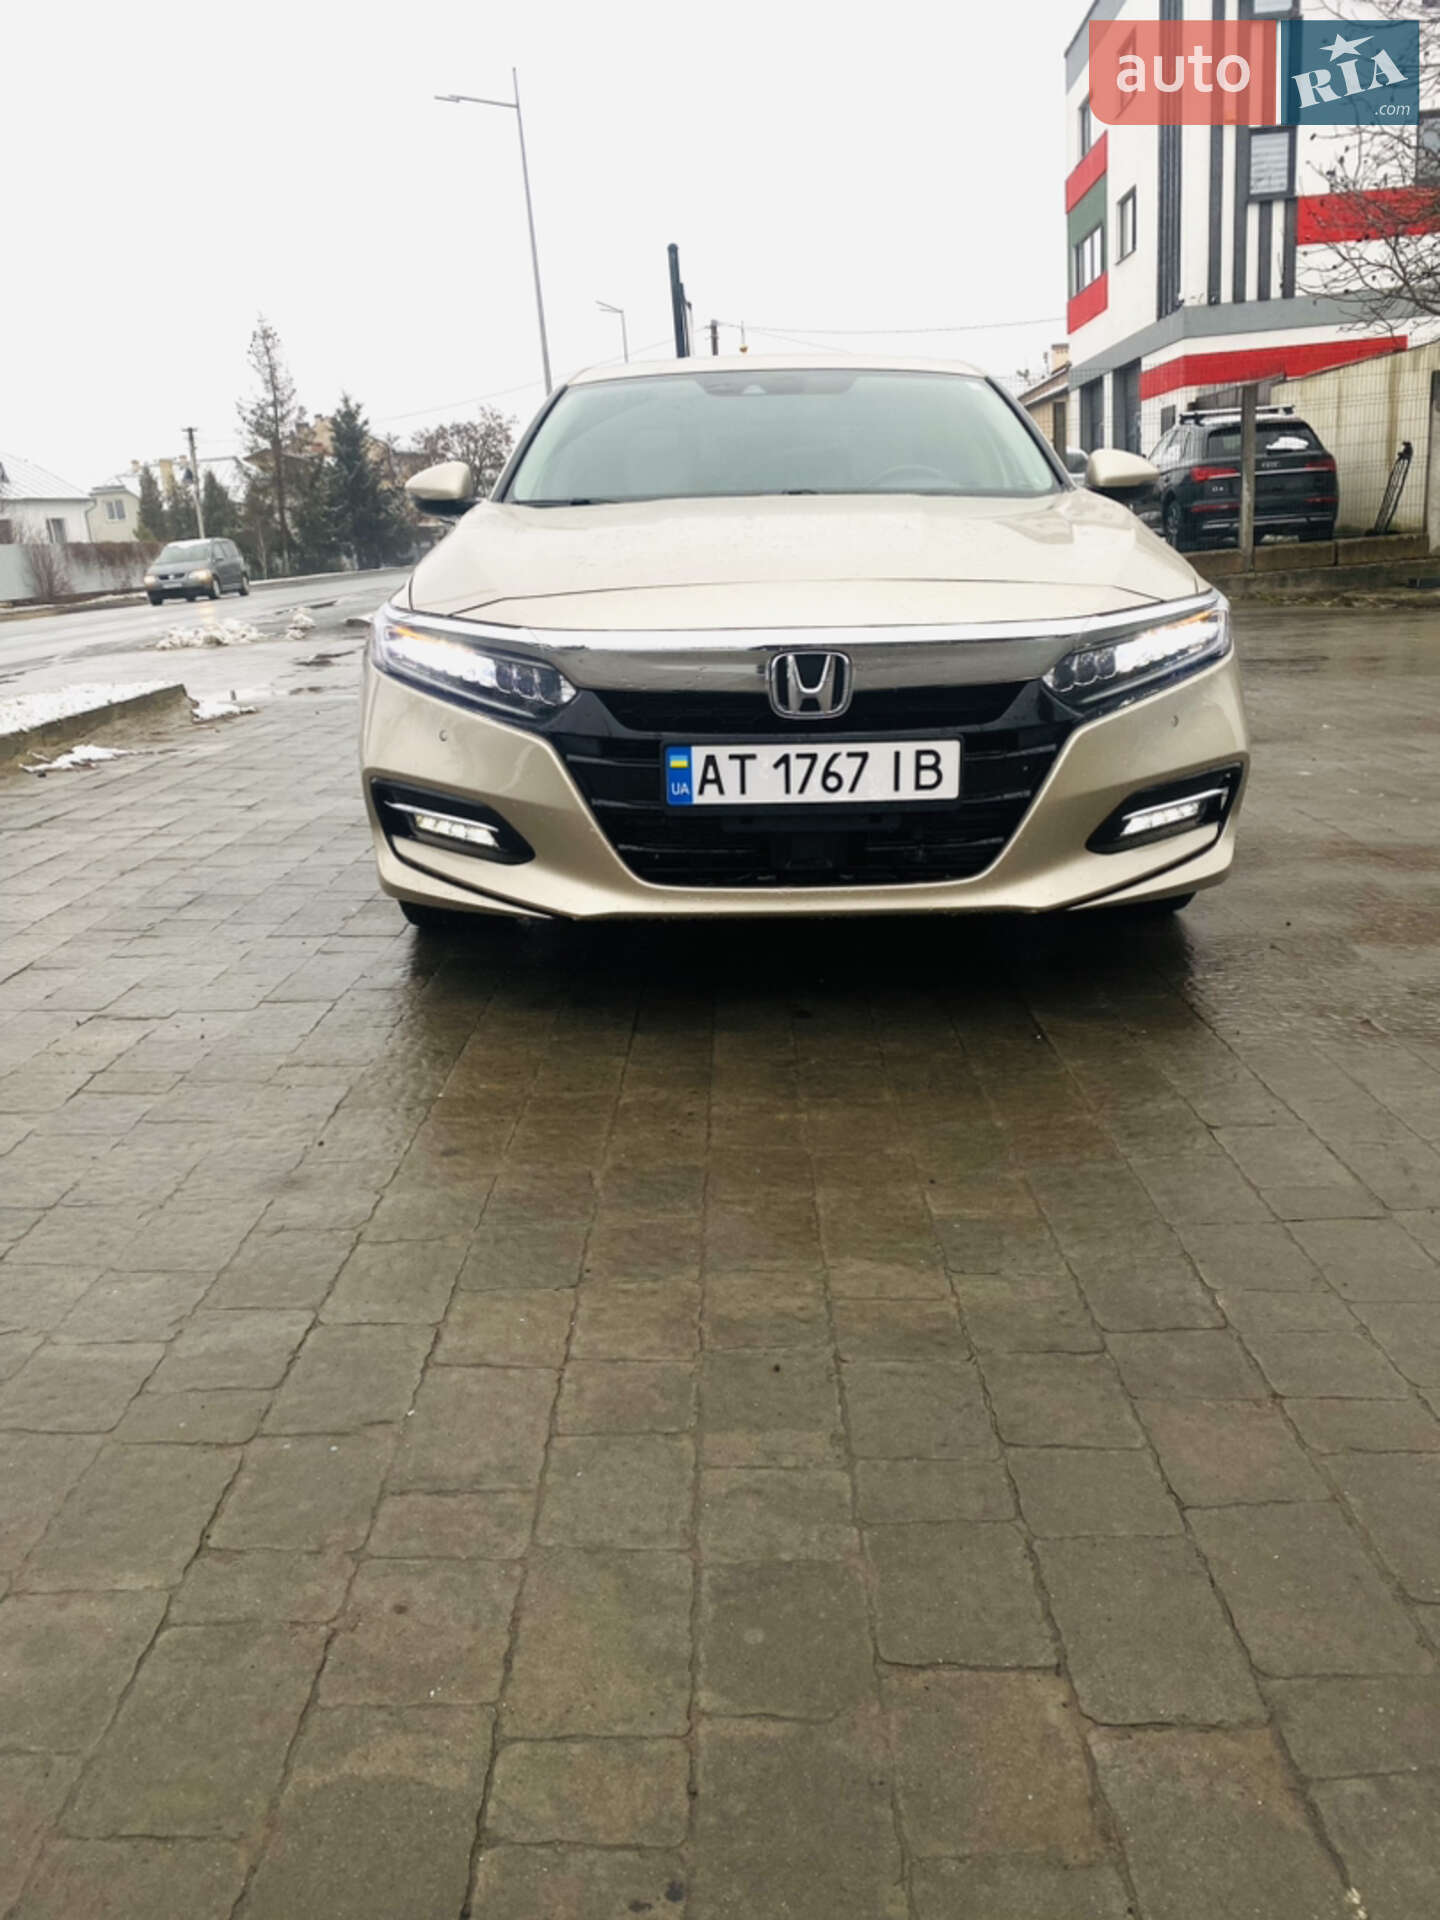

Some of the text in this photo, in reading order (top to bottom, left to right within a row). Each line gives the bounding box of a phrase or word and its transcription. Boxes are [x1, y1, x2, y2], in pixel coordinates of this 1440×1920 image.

[698, 750, 943, 795] AT 1767 IB
[671, 783, 690, 795] UA
